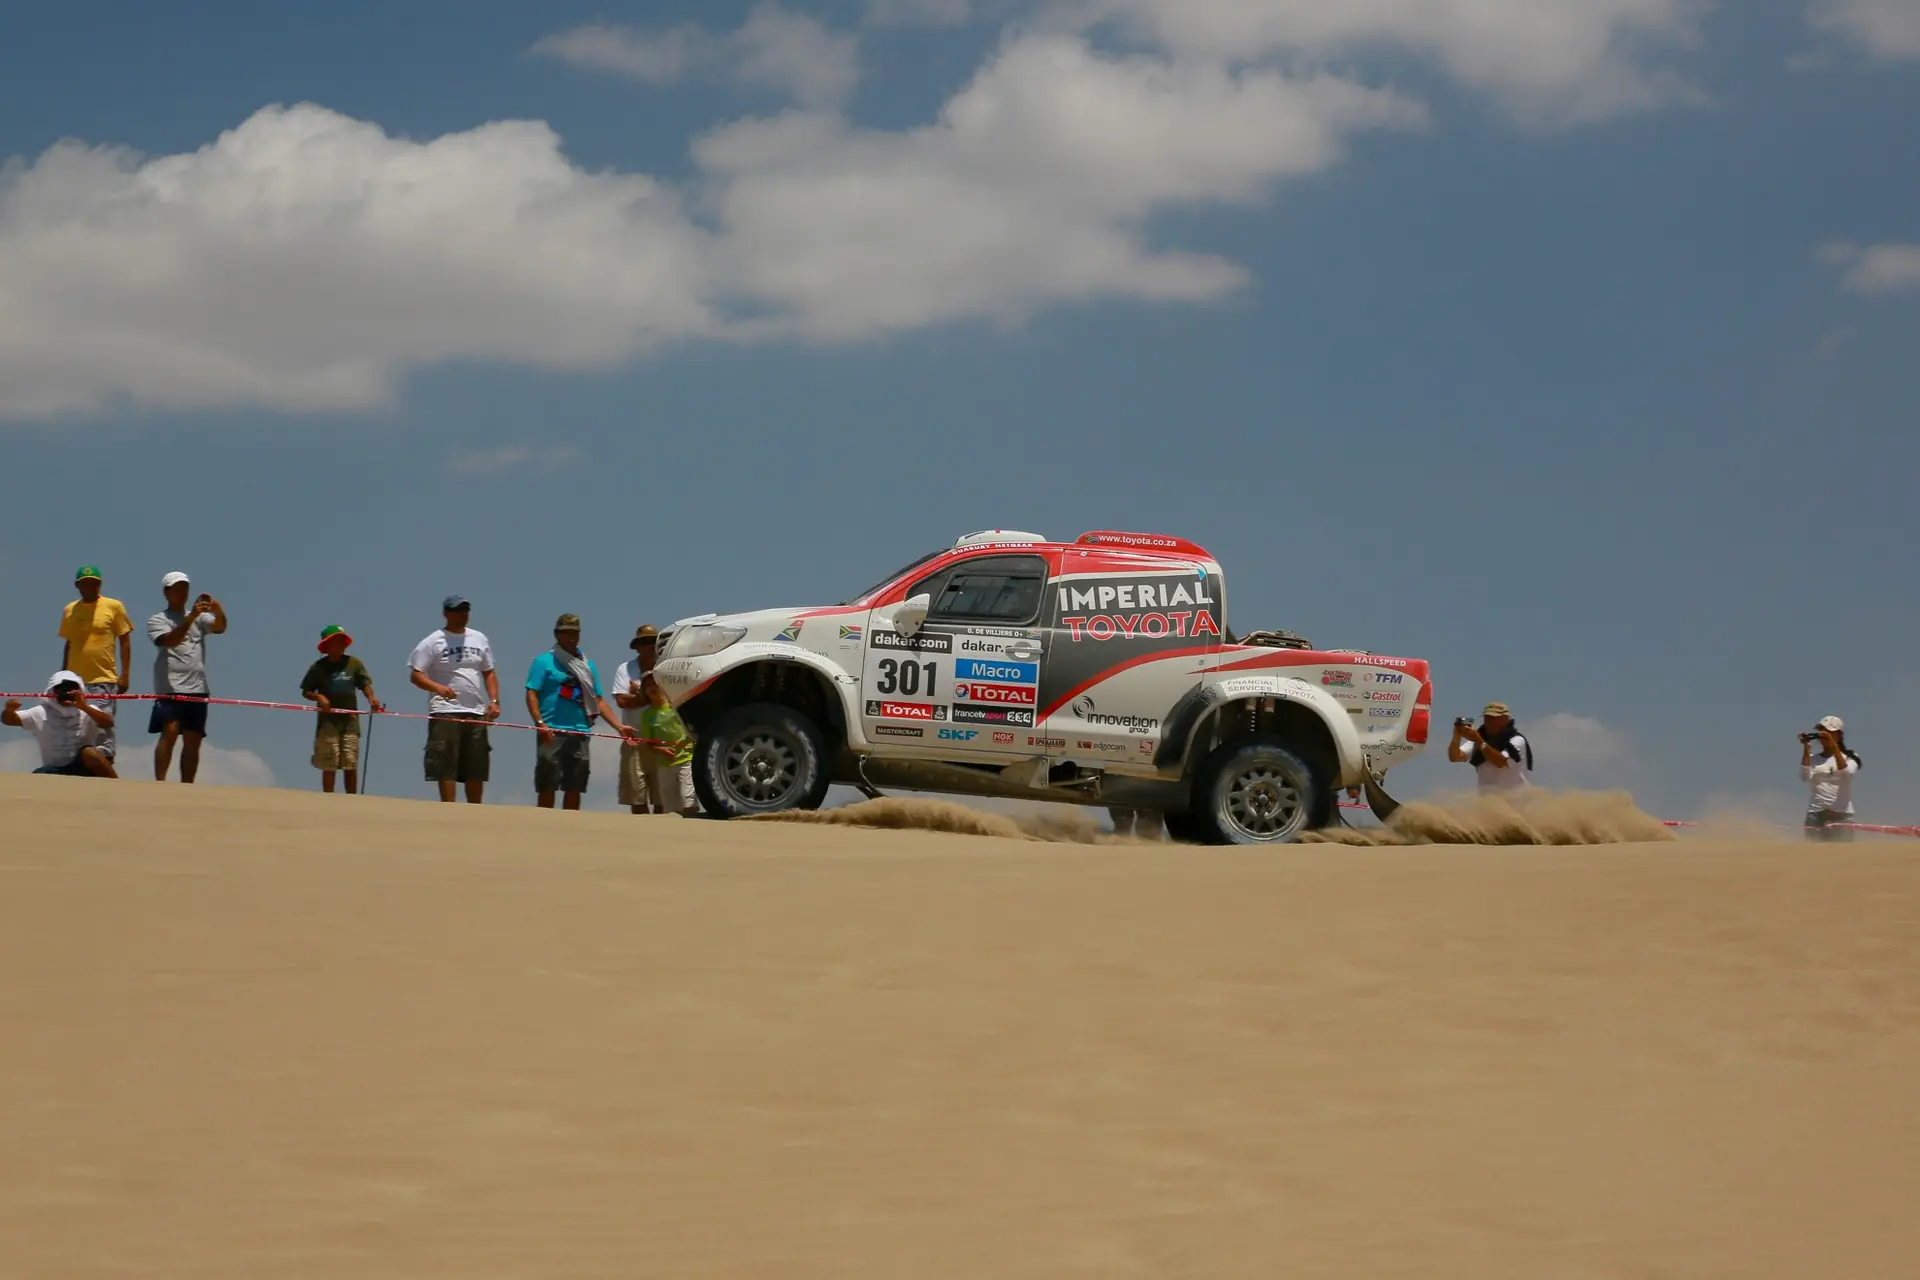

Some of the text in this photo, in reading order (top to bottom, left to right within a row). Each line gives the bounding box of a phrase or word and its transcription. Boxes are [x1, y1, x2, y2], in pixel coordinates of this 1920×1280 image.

[1098, 534, 1177, 547] www.toyota.co.za
[1059, 582, 1214, 612] IMPERIAL
[1062, 609, 1221, 642] TOYOTA
[985, 629, 1013, 637] VILLIERS
[875, 633, 948, 649] dakar.com
[1354, 657, 1407, 667] HALLSPEED
[971, 663, 1021, 679] Macro
[877, 658, 937, 697] 301
[1375, 673, 1403, 684] TFM
[1283, 688, 1317, 701] TOYOTA
[1372, 691, 1402, 701] Castrol
[1087, 713, 1158, 728] innovation
[876, 727, 921, 736] MASTERCRAFT
[937, 728, 979, 740] SKF
[1129, 726, 1149, 734] group
[993, 732, 1014, 741] NGK
[1093, 741, 1126, 752] edgecam
